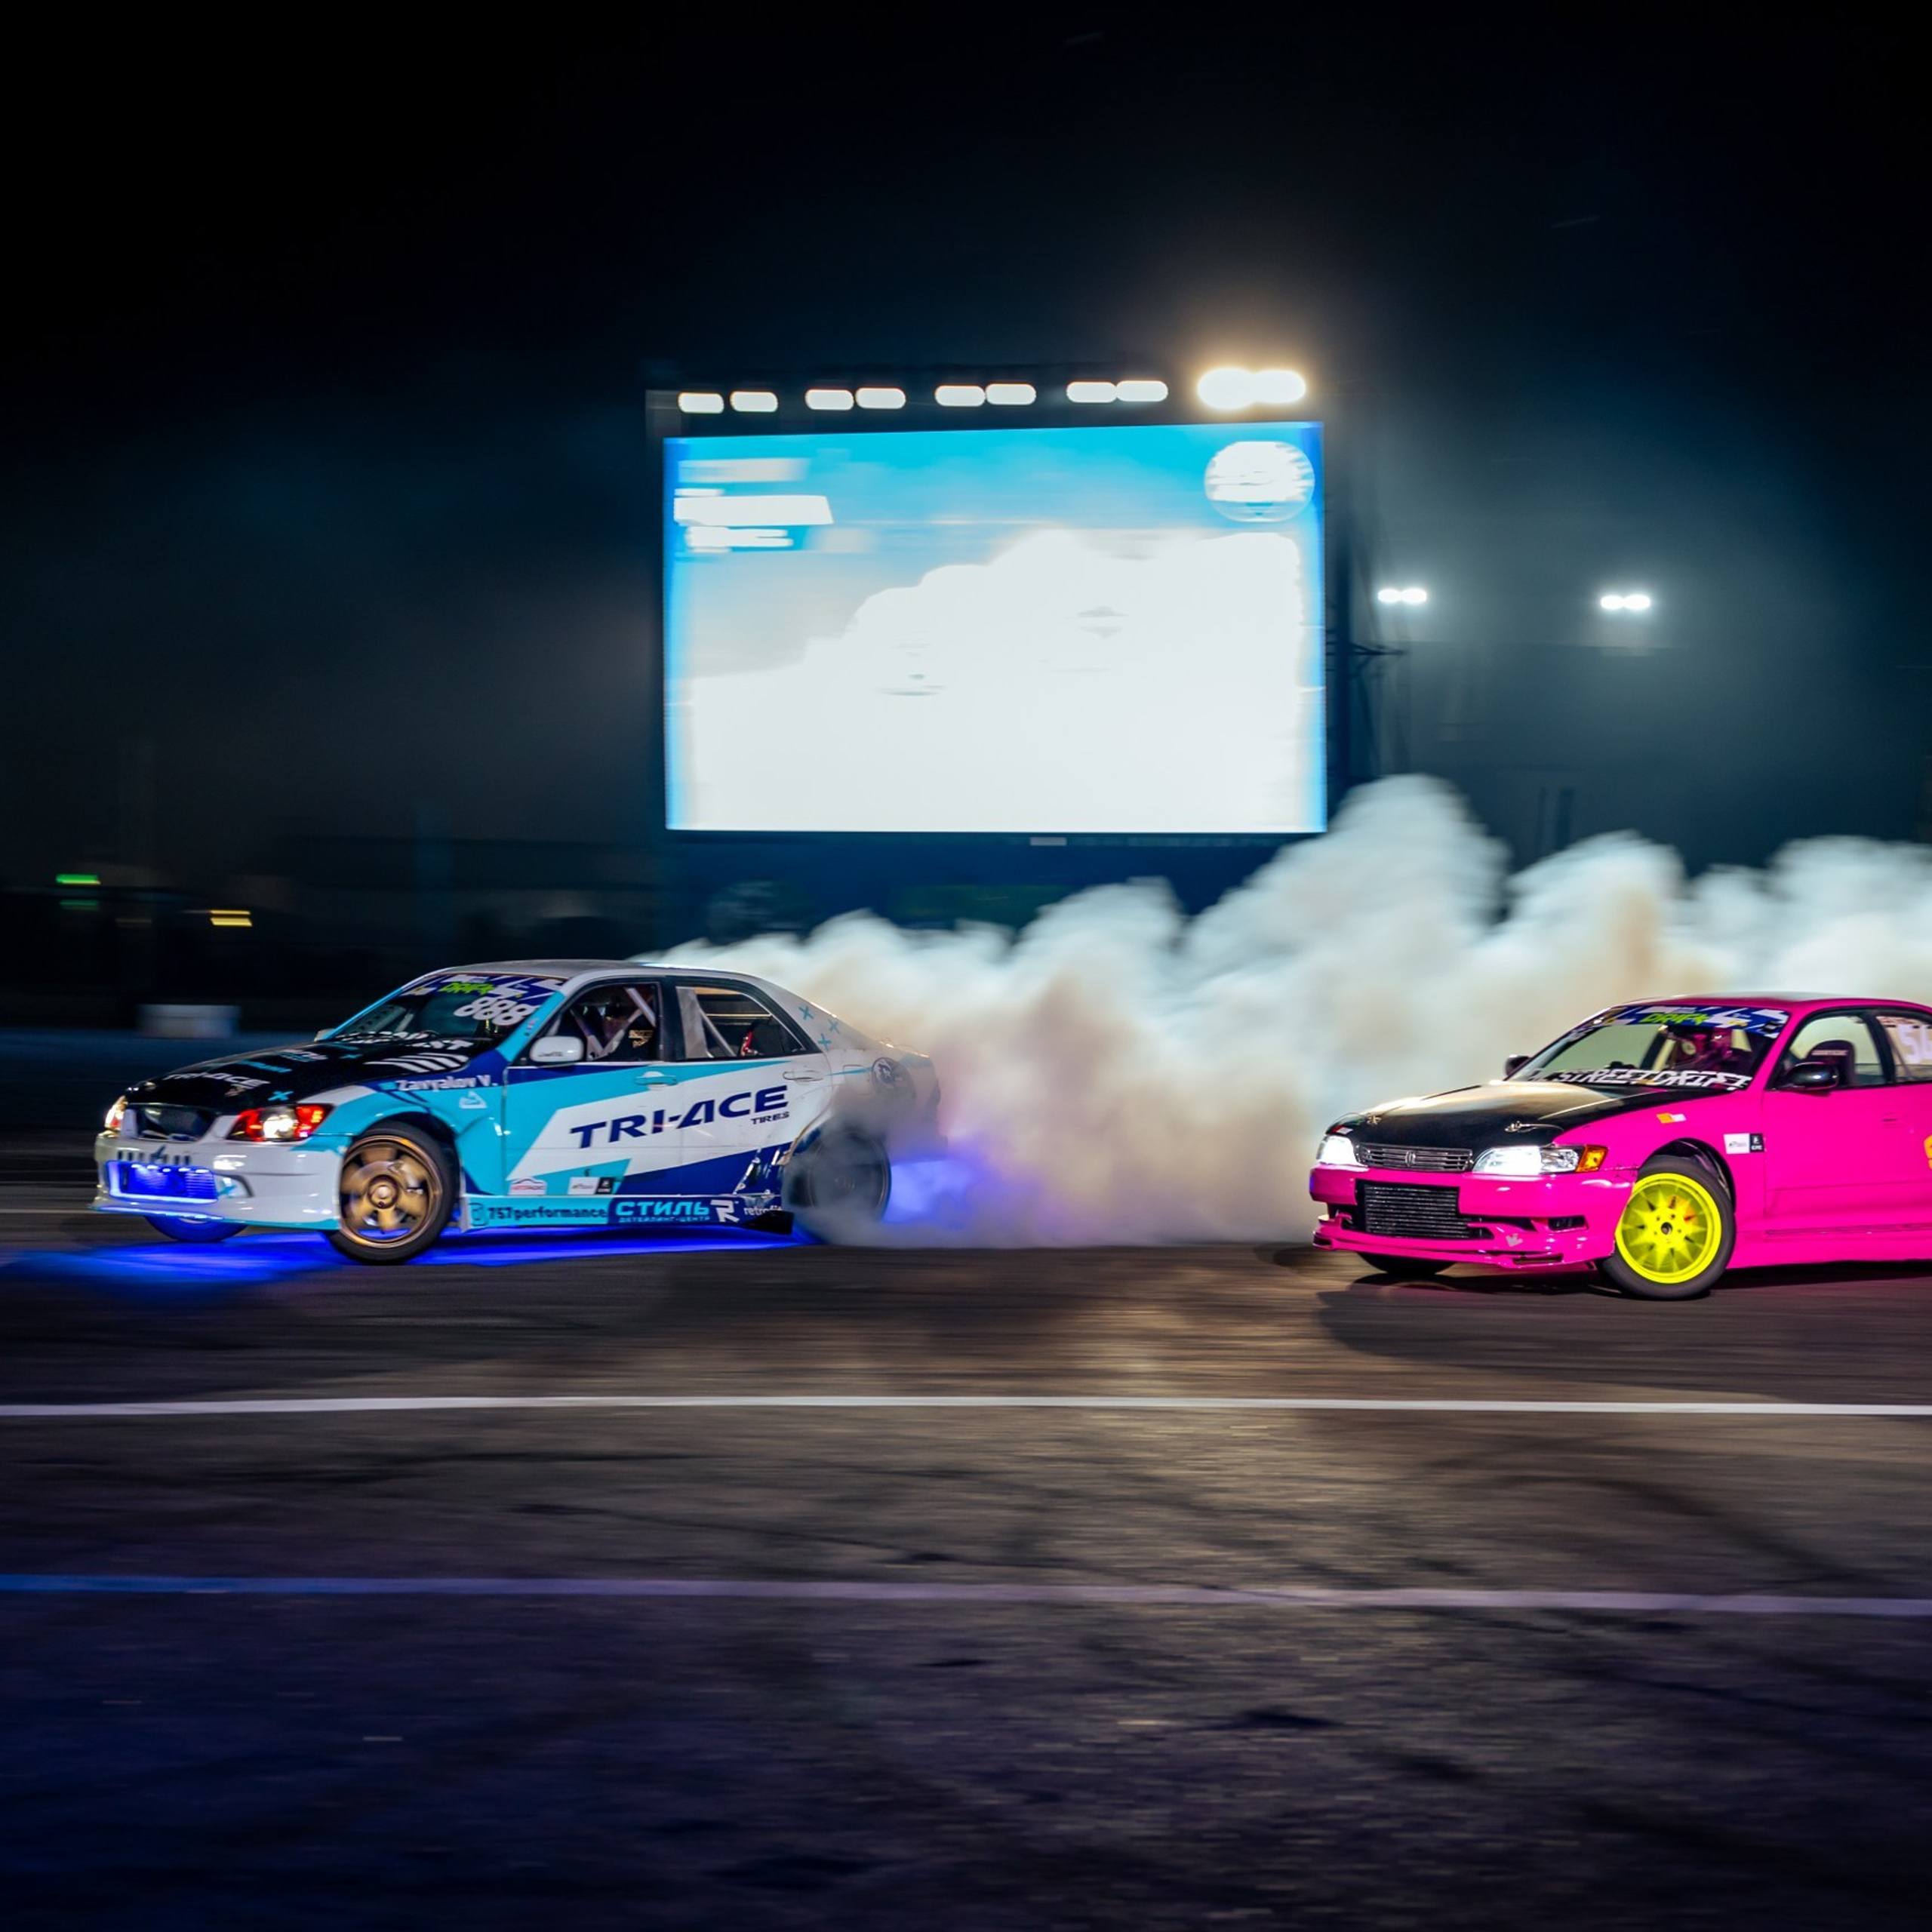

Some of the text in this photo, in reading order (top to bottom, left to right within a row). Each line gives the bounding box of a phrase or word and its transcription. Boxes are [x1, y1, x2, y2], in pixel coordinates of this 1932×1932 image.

[454, 995, 541, 1026] 888
[569, 1084, 789, 1149] TRI-ACE
[750, 1111, 789, 1124] TIRES
[615, 1201, 710, 1216] СТИЛЬ
